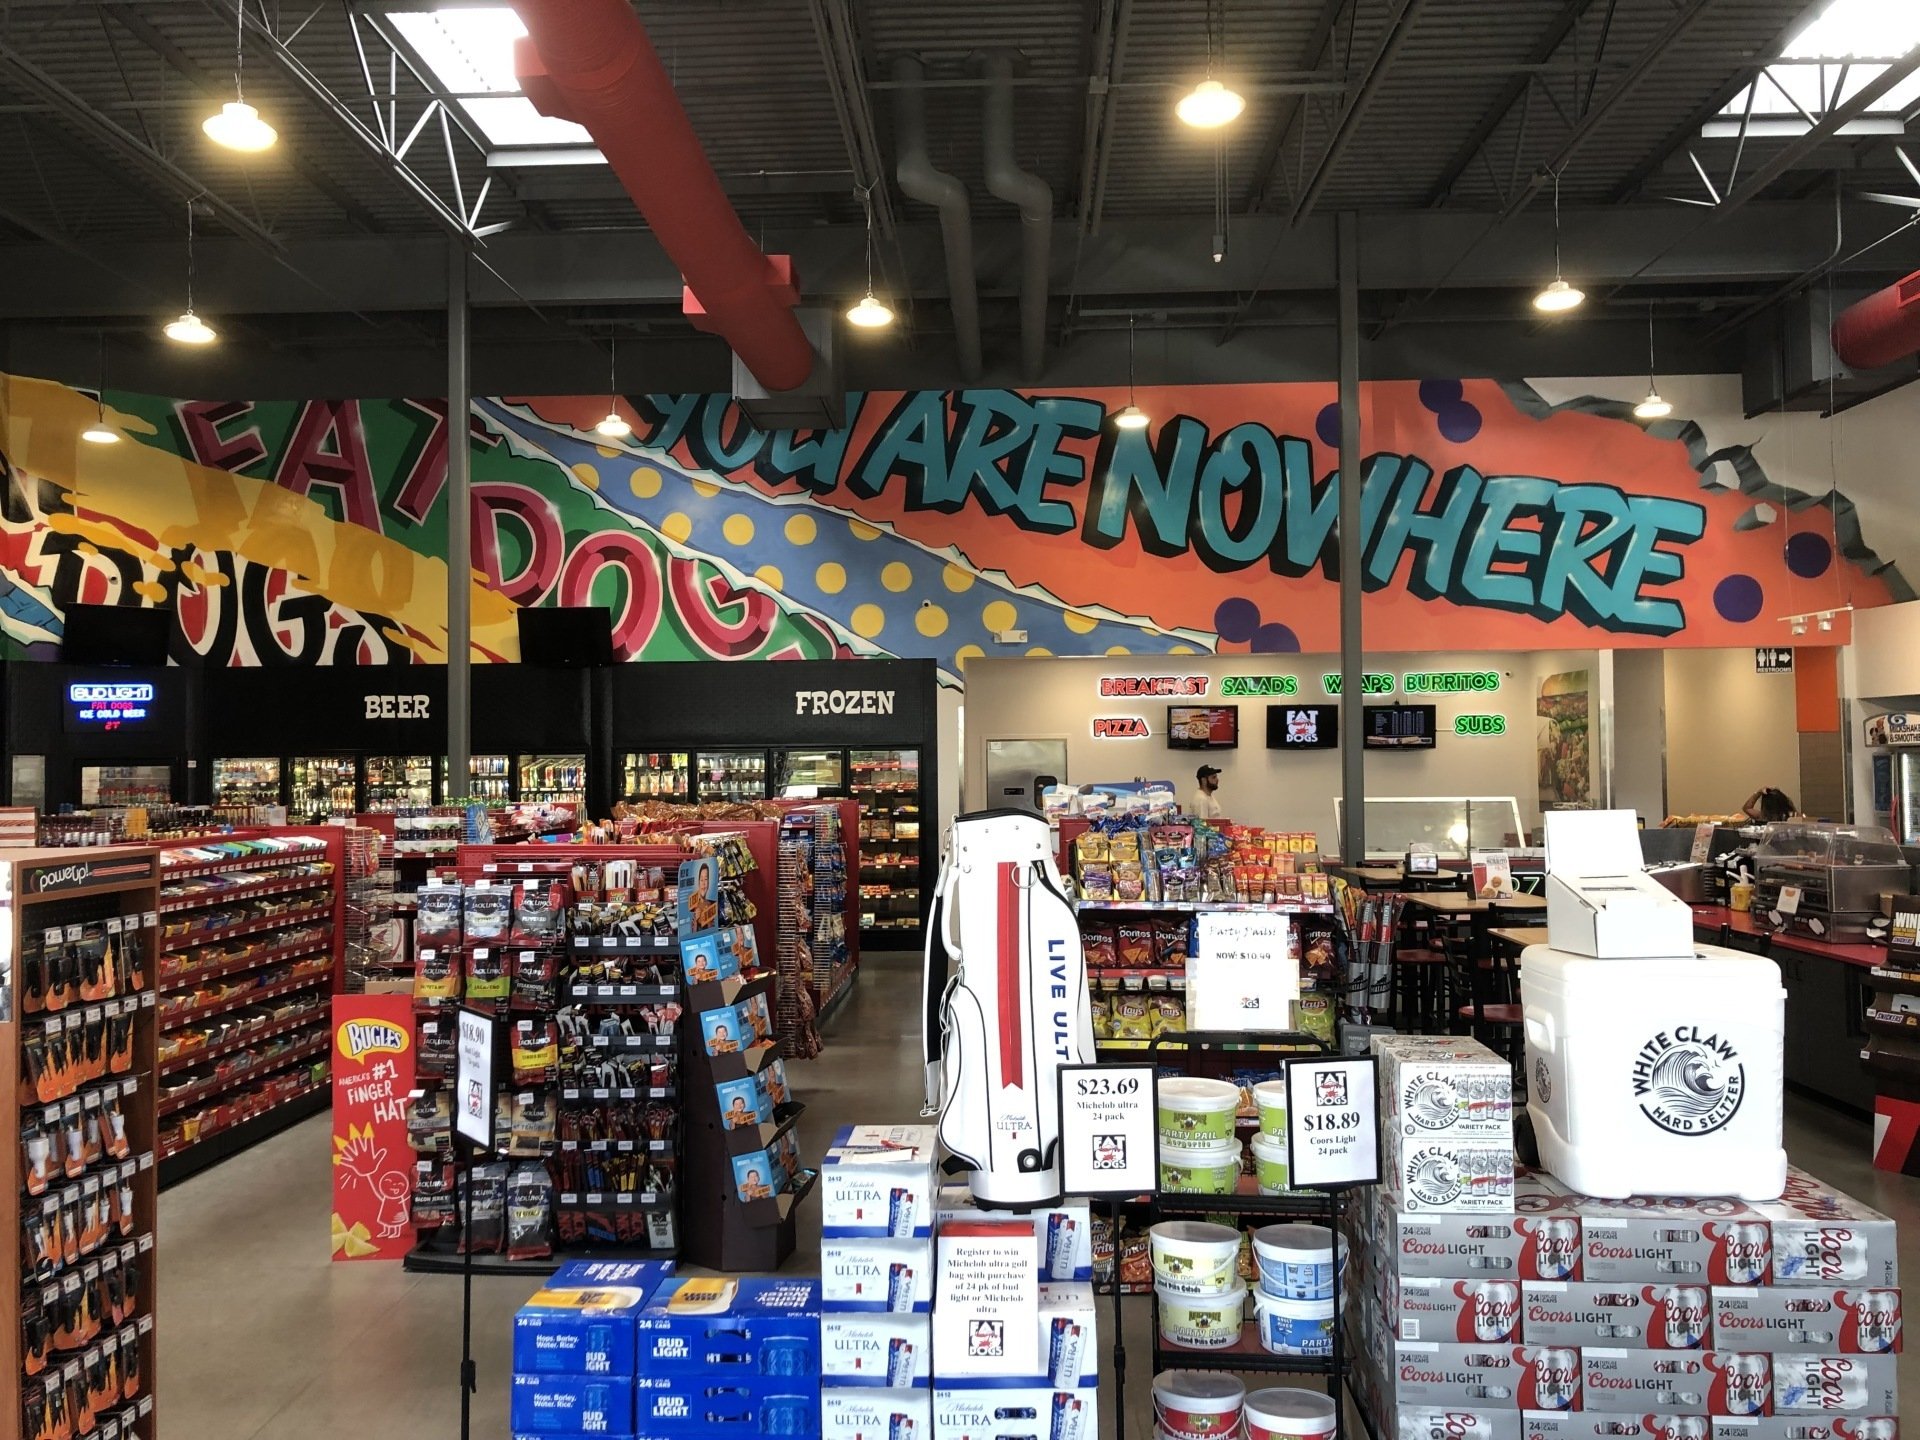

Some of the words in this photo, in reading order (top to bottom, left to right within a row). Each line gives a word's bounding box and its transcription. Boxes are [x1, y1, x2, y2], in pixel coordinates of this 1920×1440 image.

[862, 390, 1106, 535] ARE
[1082, 402, 1707, 638] NOWHERE
[1100, 677, 1209, 696] BREAKFAST
[1221, 676, 1298, 696] SALADS
[1323, 674, 1395, 694] WAPS
[1404, 672, 1499, 692] BURRITOS
[364, 694, 430, 719] BEER
[796, 690, 895, 715] FROZEN
[1286, 710, 1319, 727] FAT
[1093, 718, 1149, 737] PIZZA
[1455, 715, 1506, 735] SUBS
[1286, 733, 1319, 743] DOGS
[1119, 929, 1151, 938] Doritos
[1216, 951, 1237, 959] NOW:
[1048, 939, 1067, 998] LIVE
[346, 1022, 402, 1057] BUGLES
[461, 1021, 485, 1046] $18.90
[1632, 1031, 1672, 1097] WHITE
[1674, 1026, 1738, 1061] CLAW
[371, 1059, 399, 1081] #1
[1315, 1072, 1347, 1087] FAT
[1077, 1078, 1139, 1096] $23.69
[1403, 1074, 1425, 1109] WHITE
[1426, 1071, 1457, 1091] CLAW
[1077, 1101, 1115, 1110] Michelob
[1317, 1096, 1348, 1106] DOGS
[1652, 1106, 1693, 1130] HARD
[1699, 1075, 1740, 1129] SELTZER
[373, 1097, 408, 1124] HAT
[1104, 1112, 1126, 1122] pack
[1304, 1111, 1361, 1132] $18.89
[1414, 1114, 1436, 1127] HARD
[996, 1121, 1033, 1130] ULTRA
[1160, 1128, 1190, 1140] PARTY
[1194, 1130, 1217, 1139] PAIL
[1094, 1136, 1125, 1150] FAT
[1310, 1136, 1334, 1145] Coors
[1335, 1135, 1356, 1146] Light
[1318, 1147, 1328, 1155] 24
[1329, 1147, 1348, 1156] pack
[1094, 1159, 1126, 1169] DOGS
[1406, 1149, 1428, 1184] WHITE
[1428, 1146, 1459, 1166] CLAW
[836, 1190, 882, 1200] ULTRA
[1416, 1190, 1438, 1203] HARD
[1402, 1226, 1414, 1235] 24
[1588, 1230, 1600, 1239] 24
[956, 1248, 990, 1257] Register
[993, 1248, 1001, 1256] to
[1004, 1248, 1019, 1256] win
[1060, 1234, 1072, 1269] ULTRA
[1402, 1238, 1446, 1255] Coors
[1448, 1244, 1485, 1255] LIGHT
[1588, 1242, 1633, 1259] Coors
[1635, 1248, 1672, 1259] LIGHT
[1804, 1231, 1820, 1277] LIGHT
[948, 1259, 986, 1267] Michelob
[989, 1259, 1010, 1267] ultra
[835, 1265, 880, 1275] ULTRA
[949, 1271, 964, 1280] bag
[967, 1271, 985, 1279] with
[987, 1271, 1026, 1280] purchase
[978, 1283, 989, 1292] pk
[1403, 1288, 1414, 1296] 24
[950, 1294, 970, 1303] light
[985, 1294, 1024, 1302] Michelob
[1528, 1294, 1539, 1302] 24
[1403, 1299, 1432, 1311] Coors
[1718, 1300, 1730, 1309] 24
[1528, 1305, 1573, 1322] Coors
[1574, 1312, 1612, 1323] LIGHT
[639, 1319, 652, 1329] 24
[1477, 1316, 1510, 1328] LIGHT
[1719, 1312, 1764, 1329] Coors
[1766, 1318, 1805, 1329] LIGHT
[970, 1321, 1003, 1334] FAT
[657, 1337, 684, 1347] BUD
[834, 1339, 880, 1350] ULTRA
[1302, 1338, 1333, 1347] PARTY
[652, 1347, 689, 1358] LIGHT
[969, 1346, 1003, 1355] DOGS
[1064, 1340, 1077, 1378] ULTRA
[1400, 1354, 1411, 1362] 24
[1587, 1360, 1600, 1369] 24
[1400, 1365, 1445, 1383] Coors
[1446, 1373, 1483, 1384] LIGHT
[639, 1379, 652, 1388] 24
[1588, 1372, 1633, 1389] Coors
[1635, 1379, 1673, 1390] LIGHT
[1805, 1361, 1822, 1407] LIGHT
[657, 1396, 684, 1406] BUD
[652, 1406, 689, 1417] LIGHT
[835, 1414, 881, 1425] ULTRA
[939, 1414, 992, 1426] ULTRA
[1529, 1421, 1541, 1431] 24
[1718, 1427, 1730, 1436] 24
